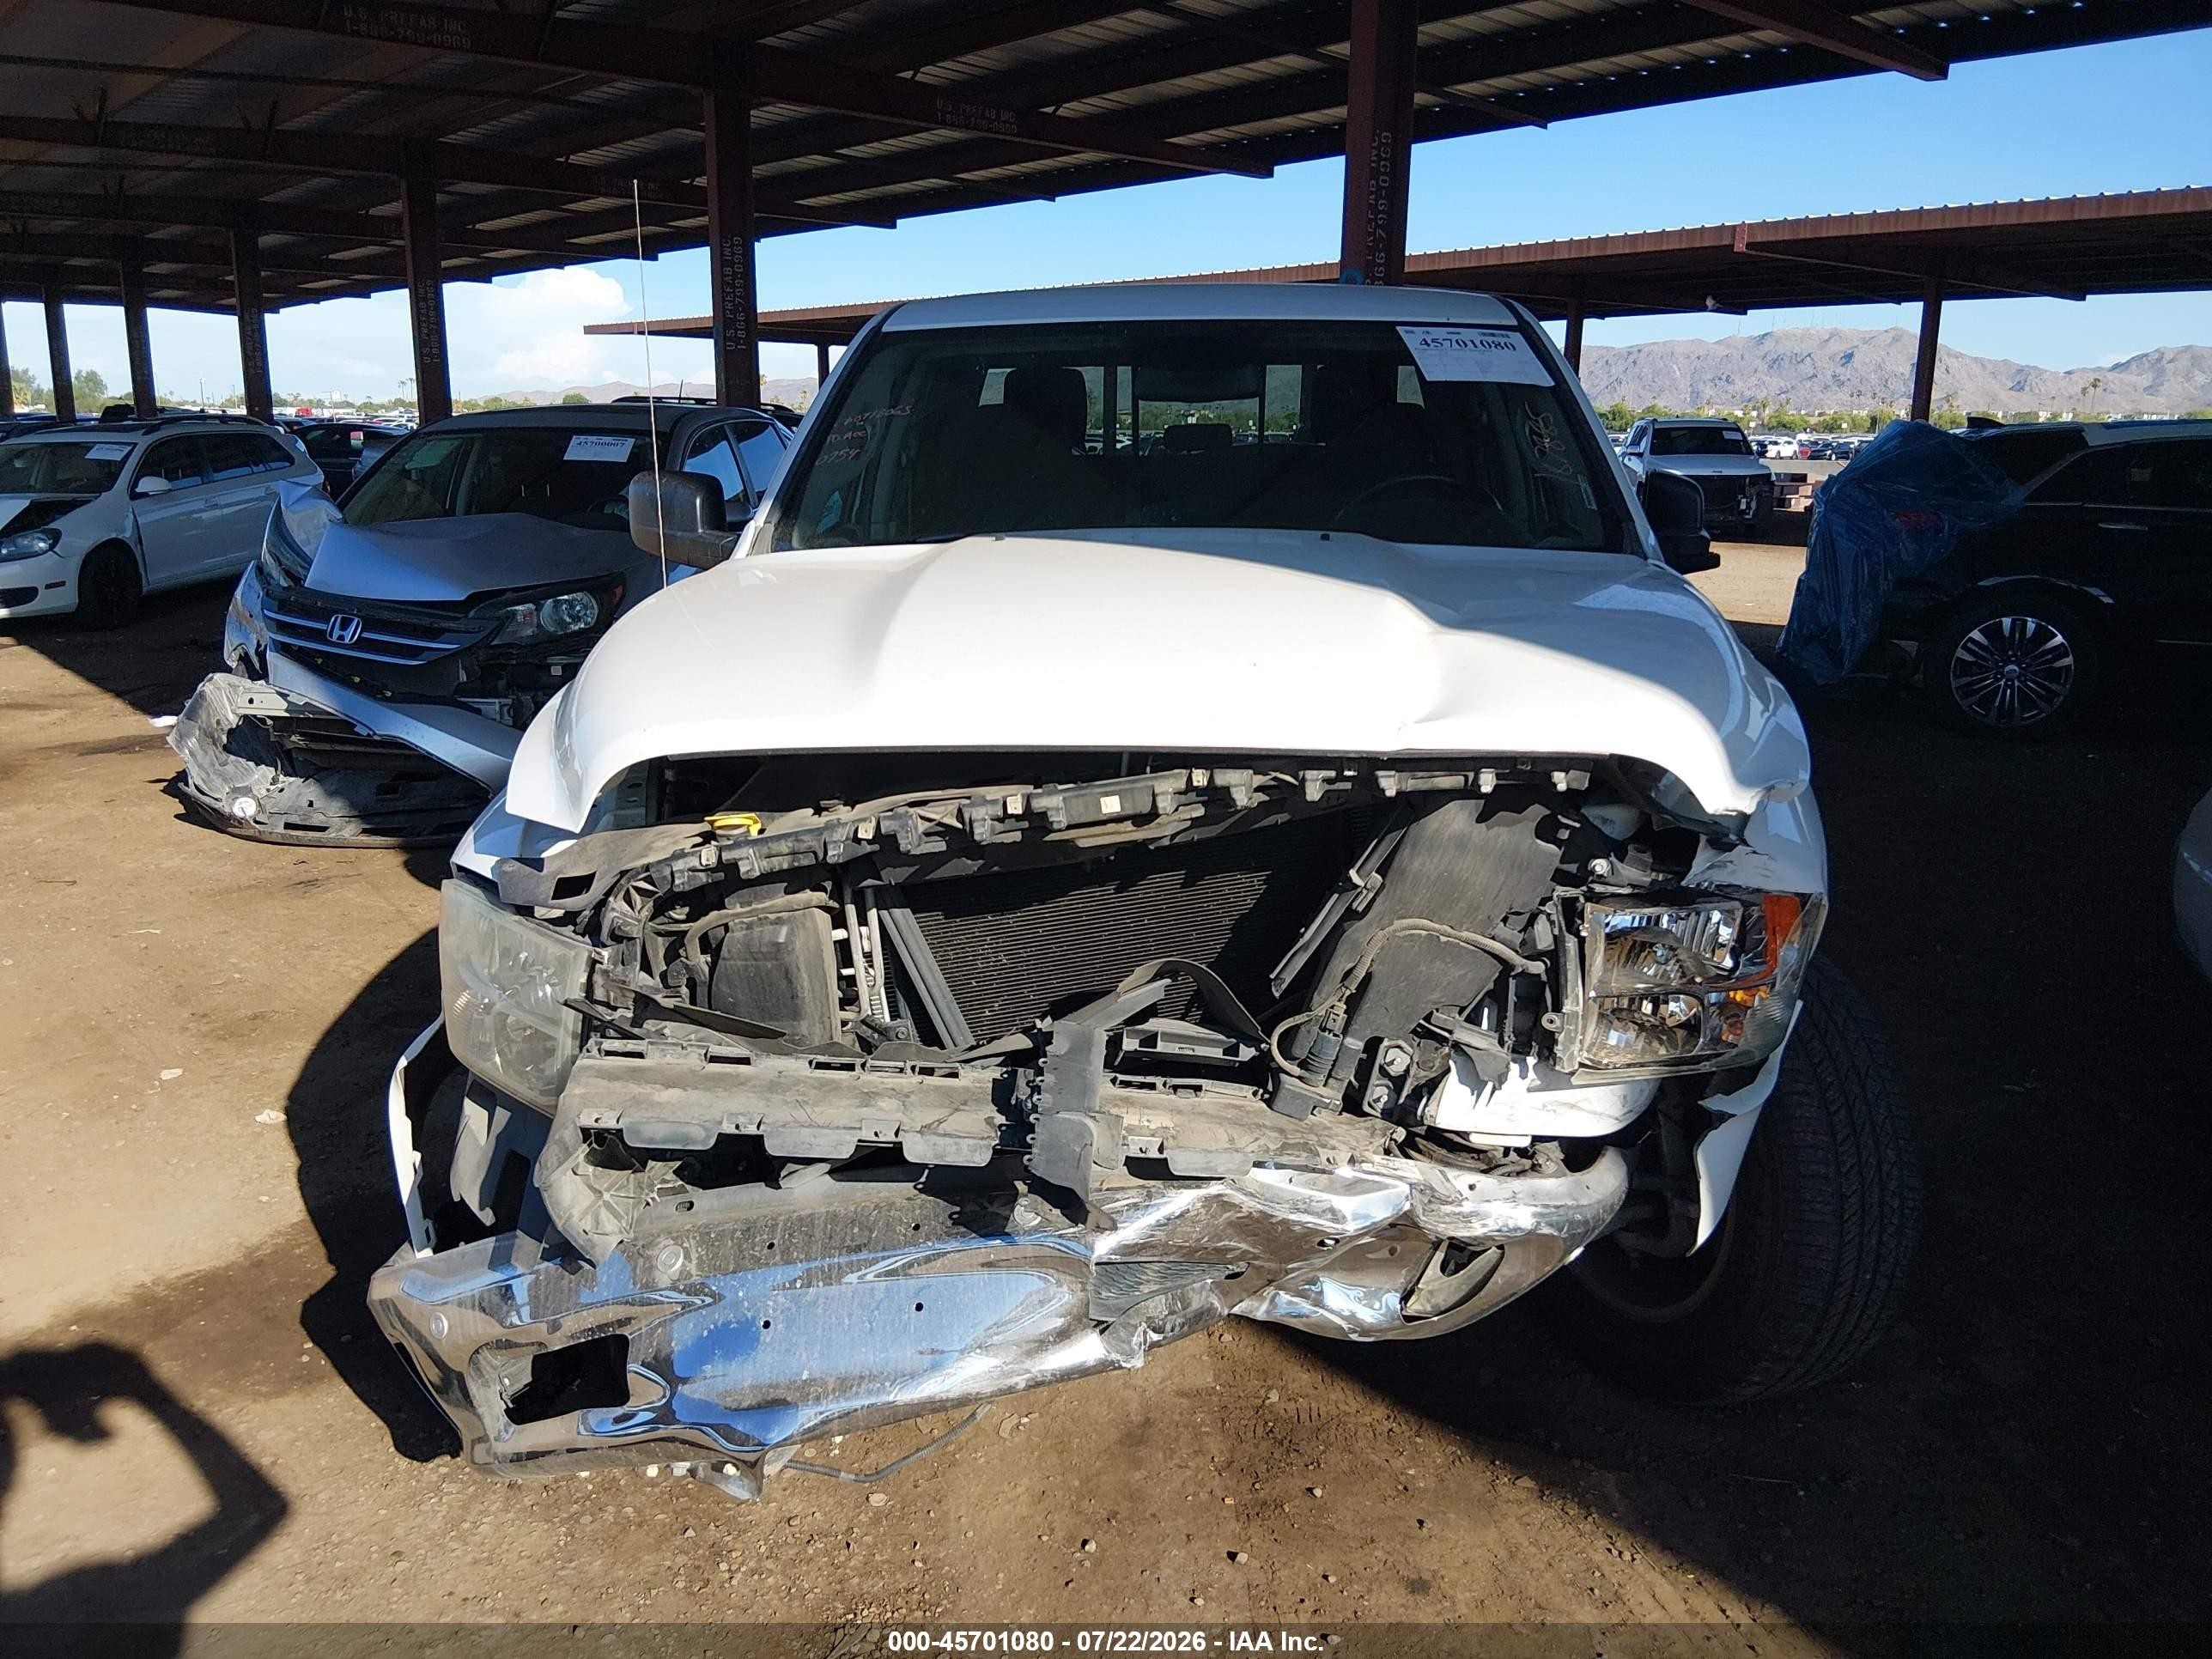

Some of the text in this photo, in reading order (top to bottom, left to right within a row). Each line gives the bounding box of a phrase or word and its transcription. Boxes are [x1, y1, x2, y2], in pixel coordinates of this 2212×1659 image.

[723, 268, 733, 319] PREFAB
[732, 236, 747, 349] 1-866-799-0969
[1419, 337, 1517, 352] 45701080
